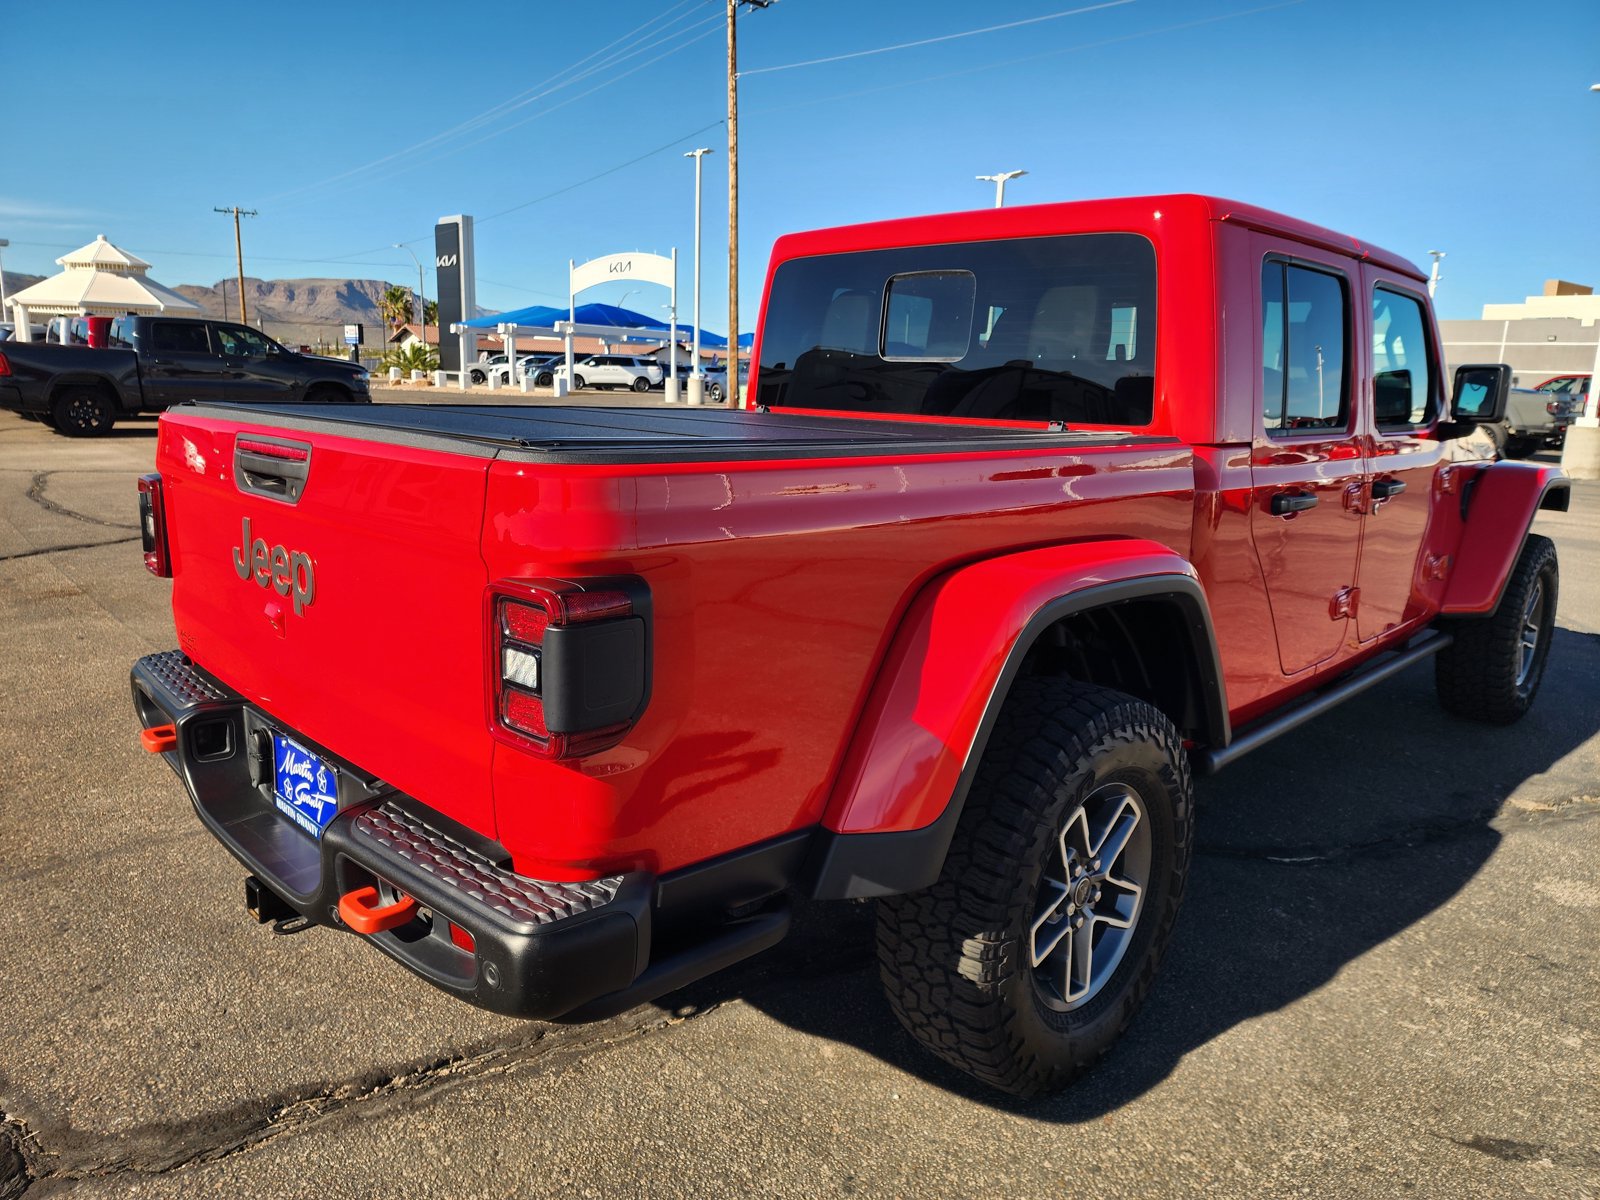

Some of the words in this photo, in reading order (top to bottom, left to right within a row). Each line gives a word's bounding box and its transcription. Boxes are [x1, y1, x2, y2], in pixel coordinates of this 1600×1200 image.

[436, 254, 457, 267] KIA
[609, 261, 632, 273] KIA
[232, 516, 315, 618] Jeep
[279, 750, 314, 783] Martin
